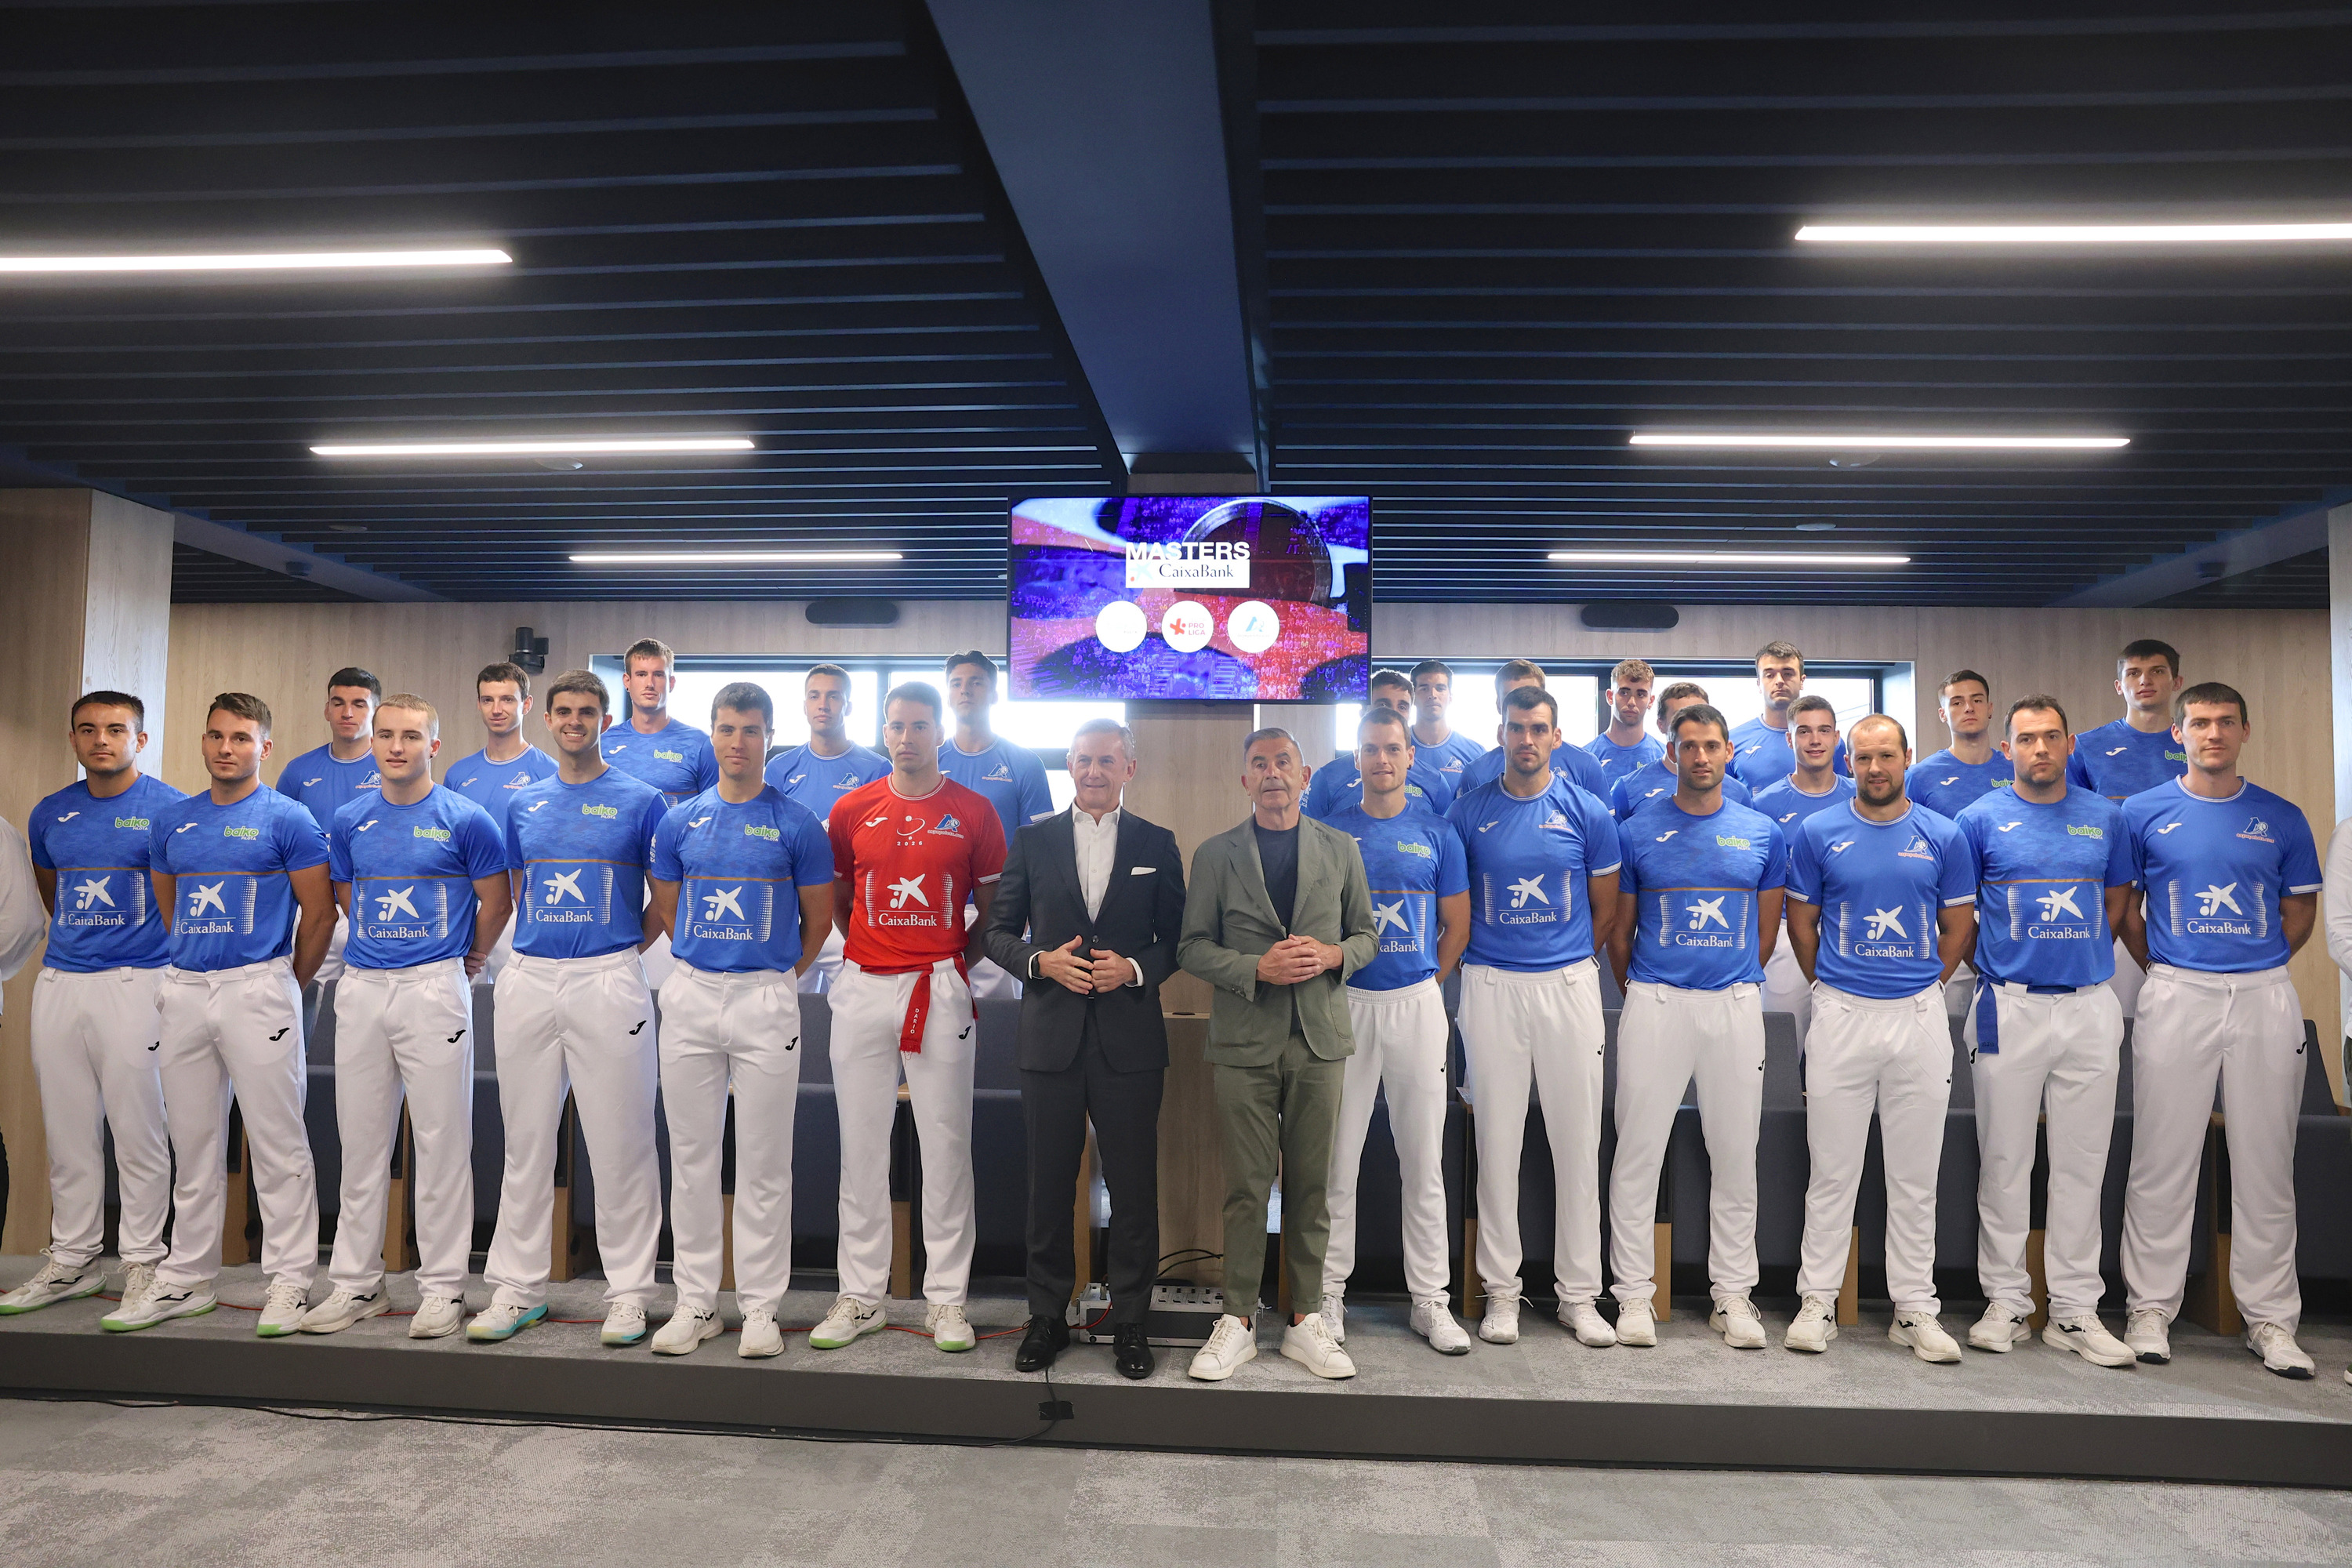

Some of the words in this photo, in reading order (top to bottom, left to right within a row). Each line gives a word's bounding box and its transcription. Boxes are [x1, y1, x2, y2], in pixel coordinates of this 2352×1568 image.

[1125, 542, 1250, 560] MASTERS
[1159, 564, 1234, 578] CaixaBank
[654, 750, 683, 760] baiko
[1404, 784, 1423, 795] aiko
[582, 804, 618, 815] baiko
[114, 816, 150, 828] baiko
[224, 826, 259, 837] baiko
[414, 826, 451, 838] baiko
[745, 824, 780, 837] baiko
[2067, 825, 2103, 836] baiko
[1398, 841, 1431, 855] baiko
[1716, 835, 1750, 848] baiko
[535, 909, 594, 923] CaixaBank
[877, 913, 938, 927] CaixaBank
[1499, 912, 1557, 924] CaixaBank
[180, 922, 234, 934] CaixaBank
[368, 925, 430, 938] CaixaBank
[693, 926, 753, 940] CaixaBank
[2027, 926, 2090, 939] CaixaBank
[2187, 920, 2251, 934] CaixaBank
[1379, 940, 1418, 953] xaBank
[1675, 934, 1733, 947] CaixaBank
[1855, 943, 1915, 958] CaixaBank
[910, 1008, 920, 1034] DARIO
